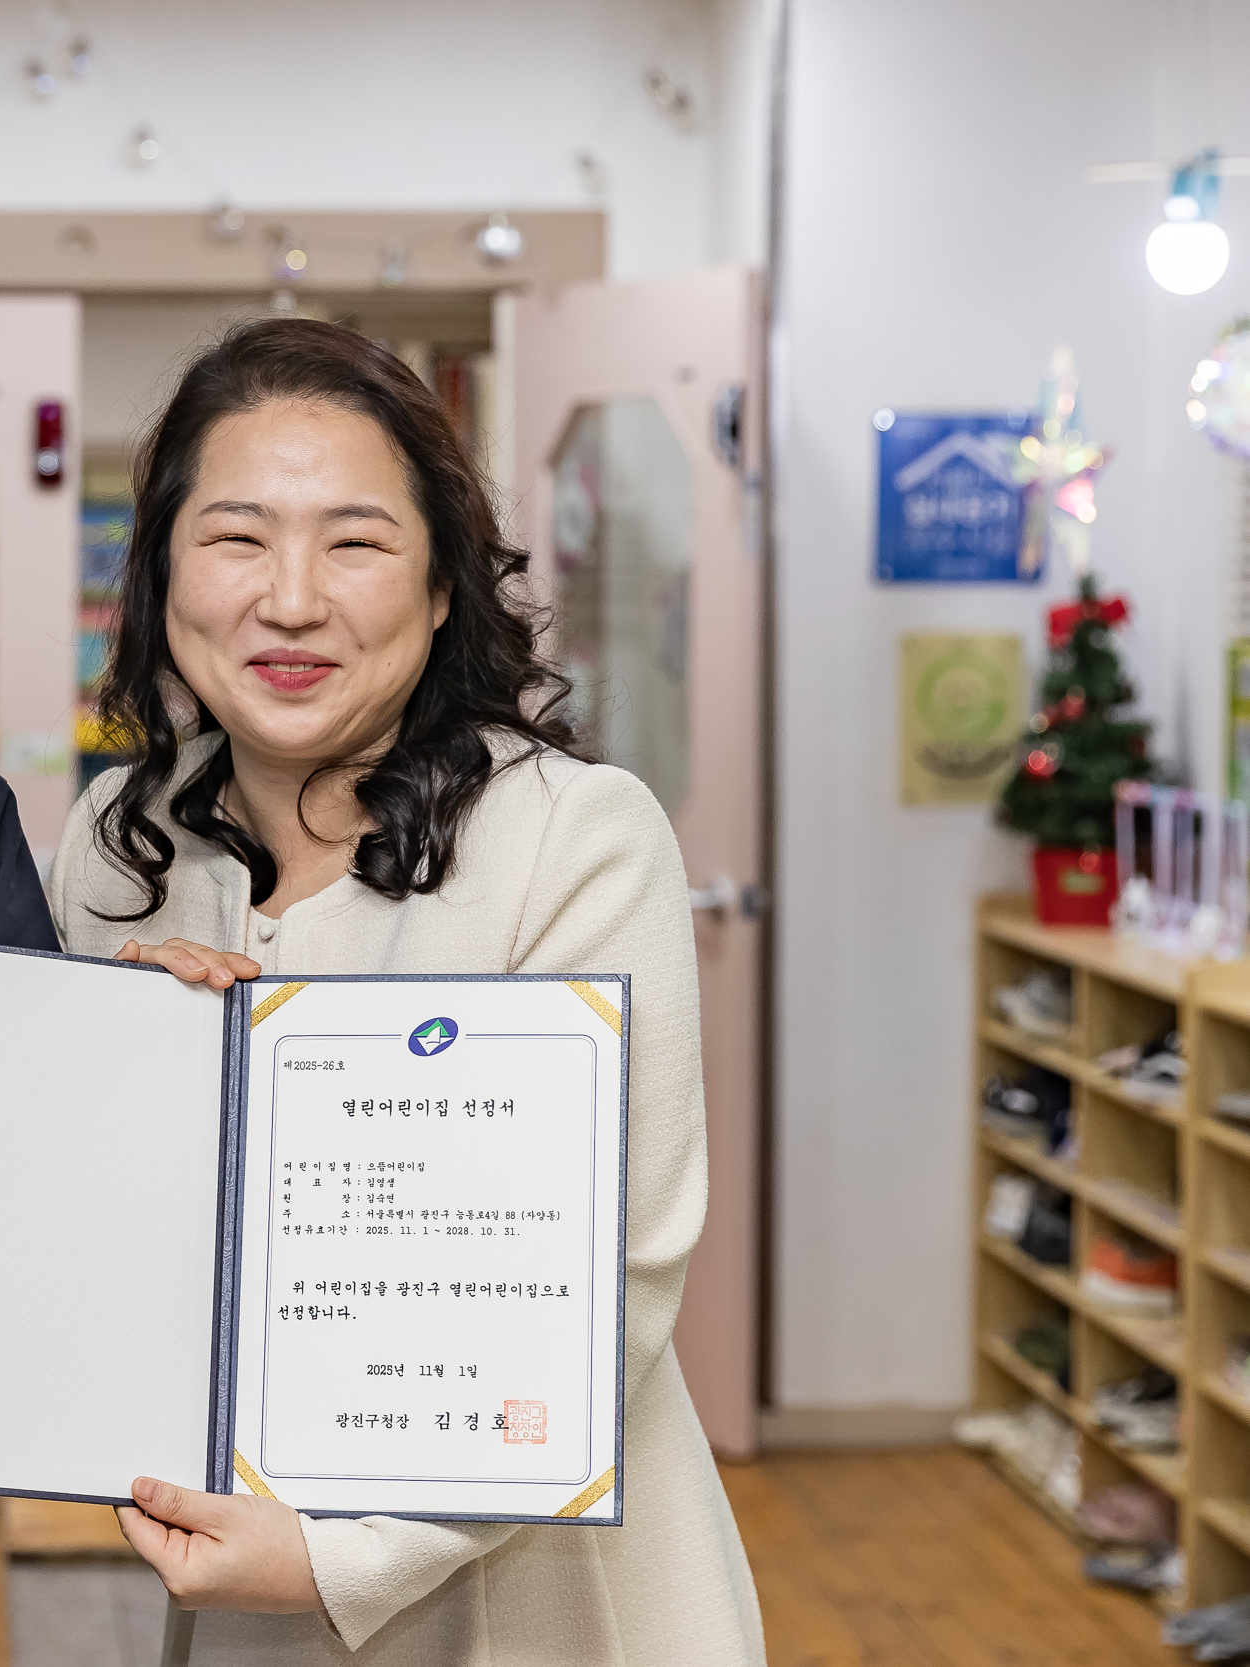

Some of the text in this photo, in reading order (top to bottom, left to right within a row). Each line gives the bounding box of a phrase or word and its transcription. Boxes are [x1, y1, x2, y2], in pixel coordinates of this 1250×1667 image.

[283, 1060, 345, 1071] 제2025-26호
[342, 1098, 514, 1118] 열린어린이집 선정서
[367, 1161, 425, 1172] 으뜸어린이집
[367, 1177, 395, 1188] 김영생
[365, 1209, 414, 1220] 서울특별시
[420, 1209, 450, 1220] 광진구
[455, 1209, 499, 1221] 능동로4길
[505, 1211, 516, 1220] 88
[521, 1210, 561, 1221] (자양동)
[281, 1224, 348, 1236] 선정유효기간
[365, 1226, 393, 1235] 2025.
[400, 1226, 416, 1235] 11.
[423, 1226, 429, 1235] 1
[446, 1226, 474, 1236] 2028.
[480, 1226, 497, 1236] 10.
[503, 1227, 520, 1236] 31.
[292, 1280, 570, 1298] 위 어린이집을 광진구 열린어린이집으로
[277, 1304, 357, 1321] 선정합니다.
[366, 1363, 478, 1379] 2025년 11월 1일
[335, 1412, 410, 1430] 광진구청장
